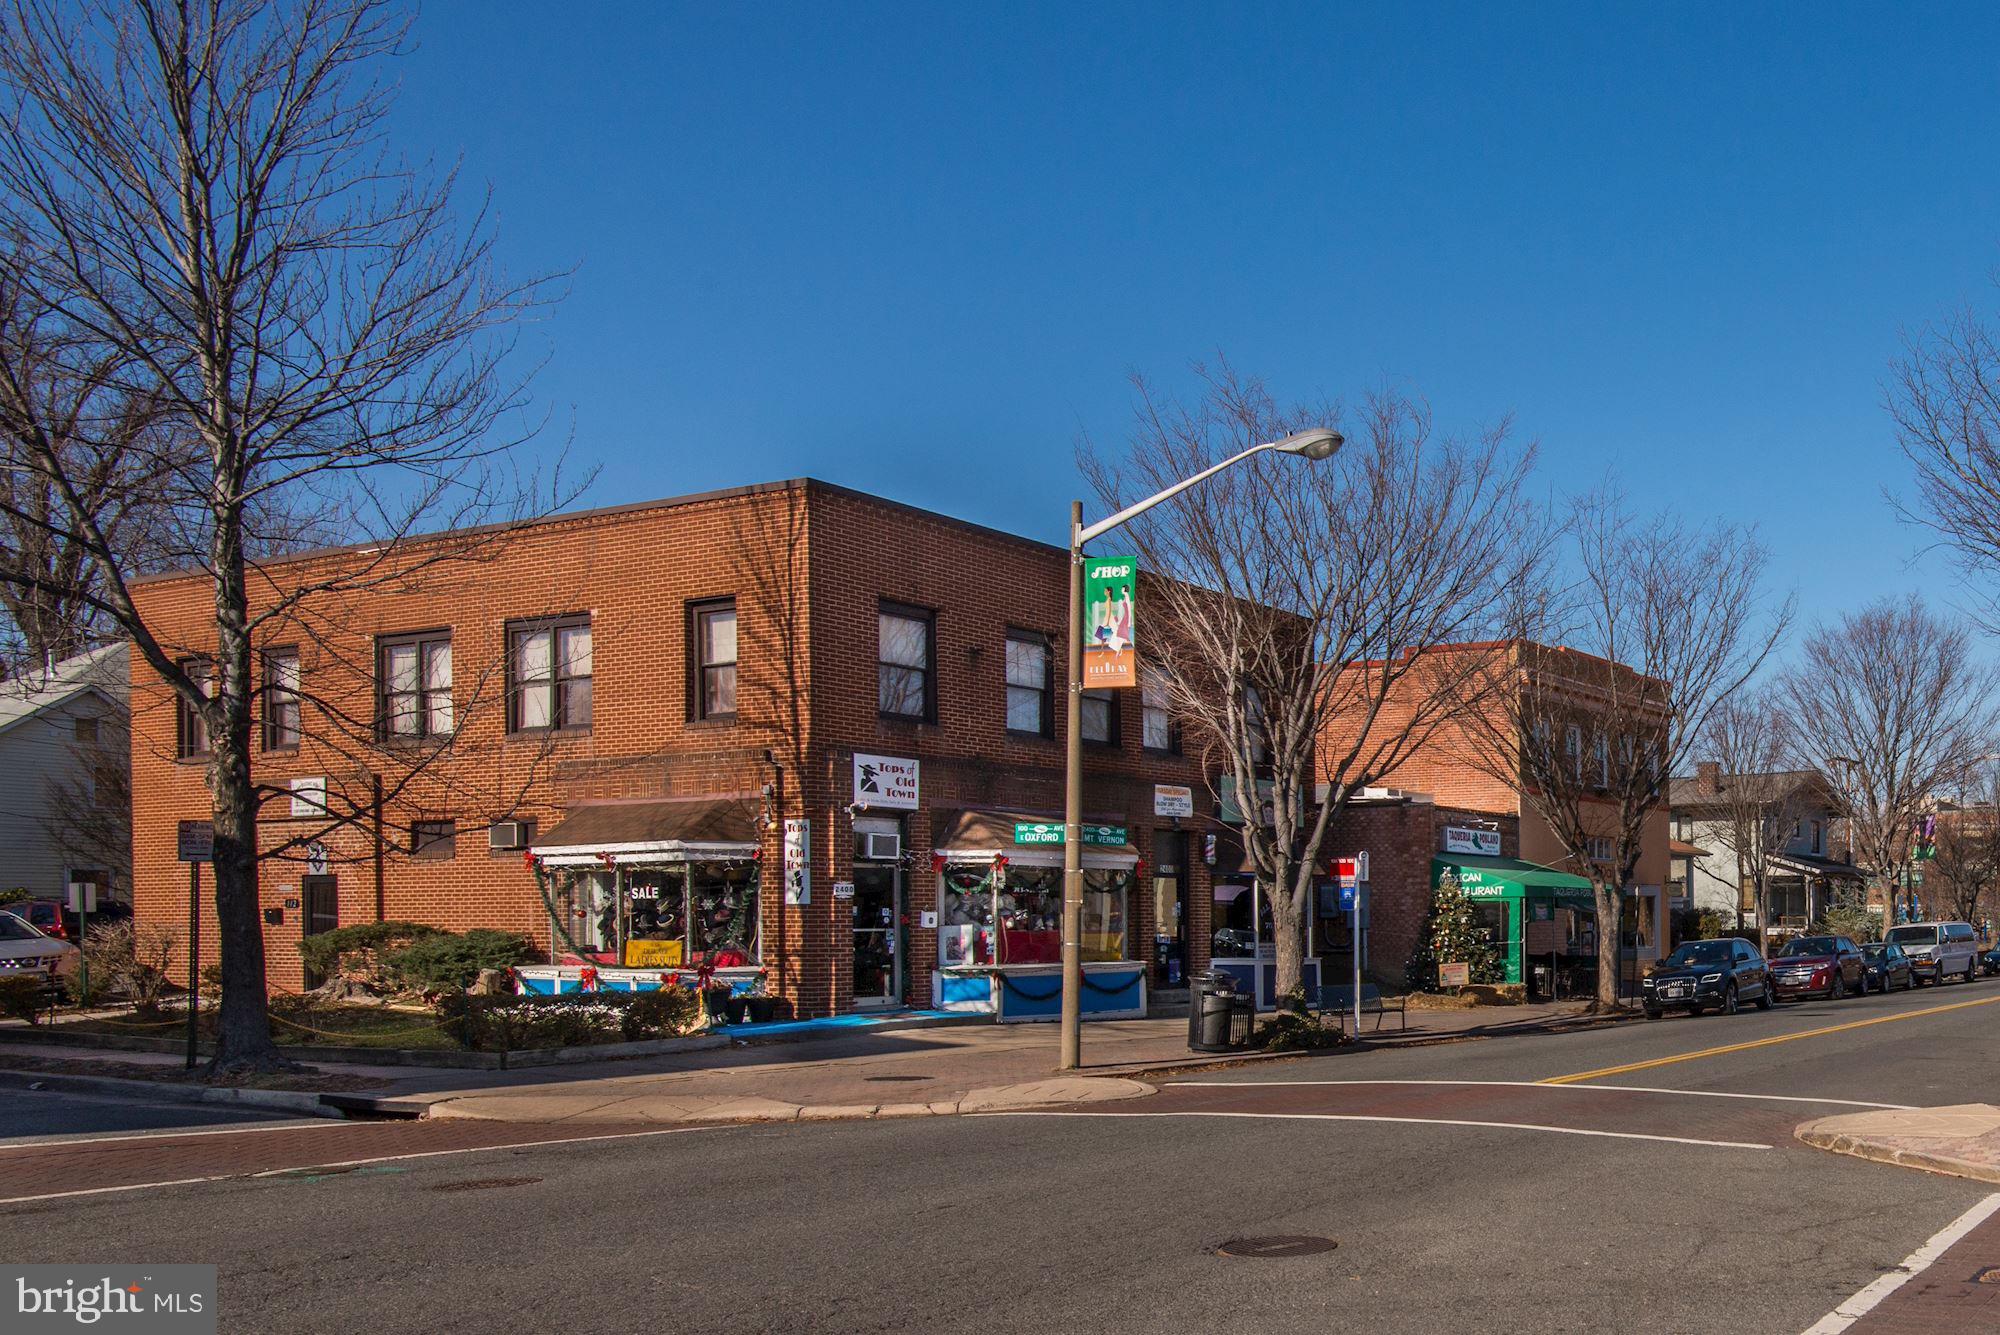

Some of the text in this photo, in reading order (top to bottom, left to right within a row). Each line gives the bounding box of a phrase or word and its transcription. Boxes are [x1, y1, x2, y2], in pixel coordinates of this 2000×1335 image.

[1091, 565, 1130, 579] SHOP
[878, 761, 915, 778] Tops of
[896, 776, 915, 787] Old
[885, 787, 915, 799] Town
[787, 823, 808, 833] Tops
[1024, 832, 1059, 842] OXFORD
[1098, 835, 1125, 845] VERNON
[789, 849, 805, 858] Old
[787, 861, 810, 870] Town
[631, 886, 660, 900] SALE
[630, 955, 658, 965] LADIES
